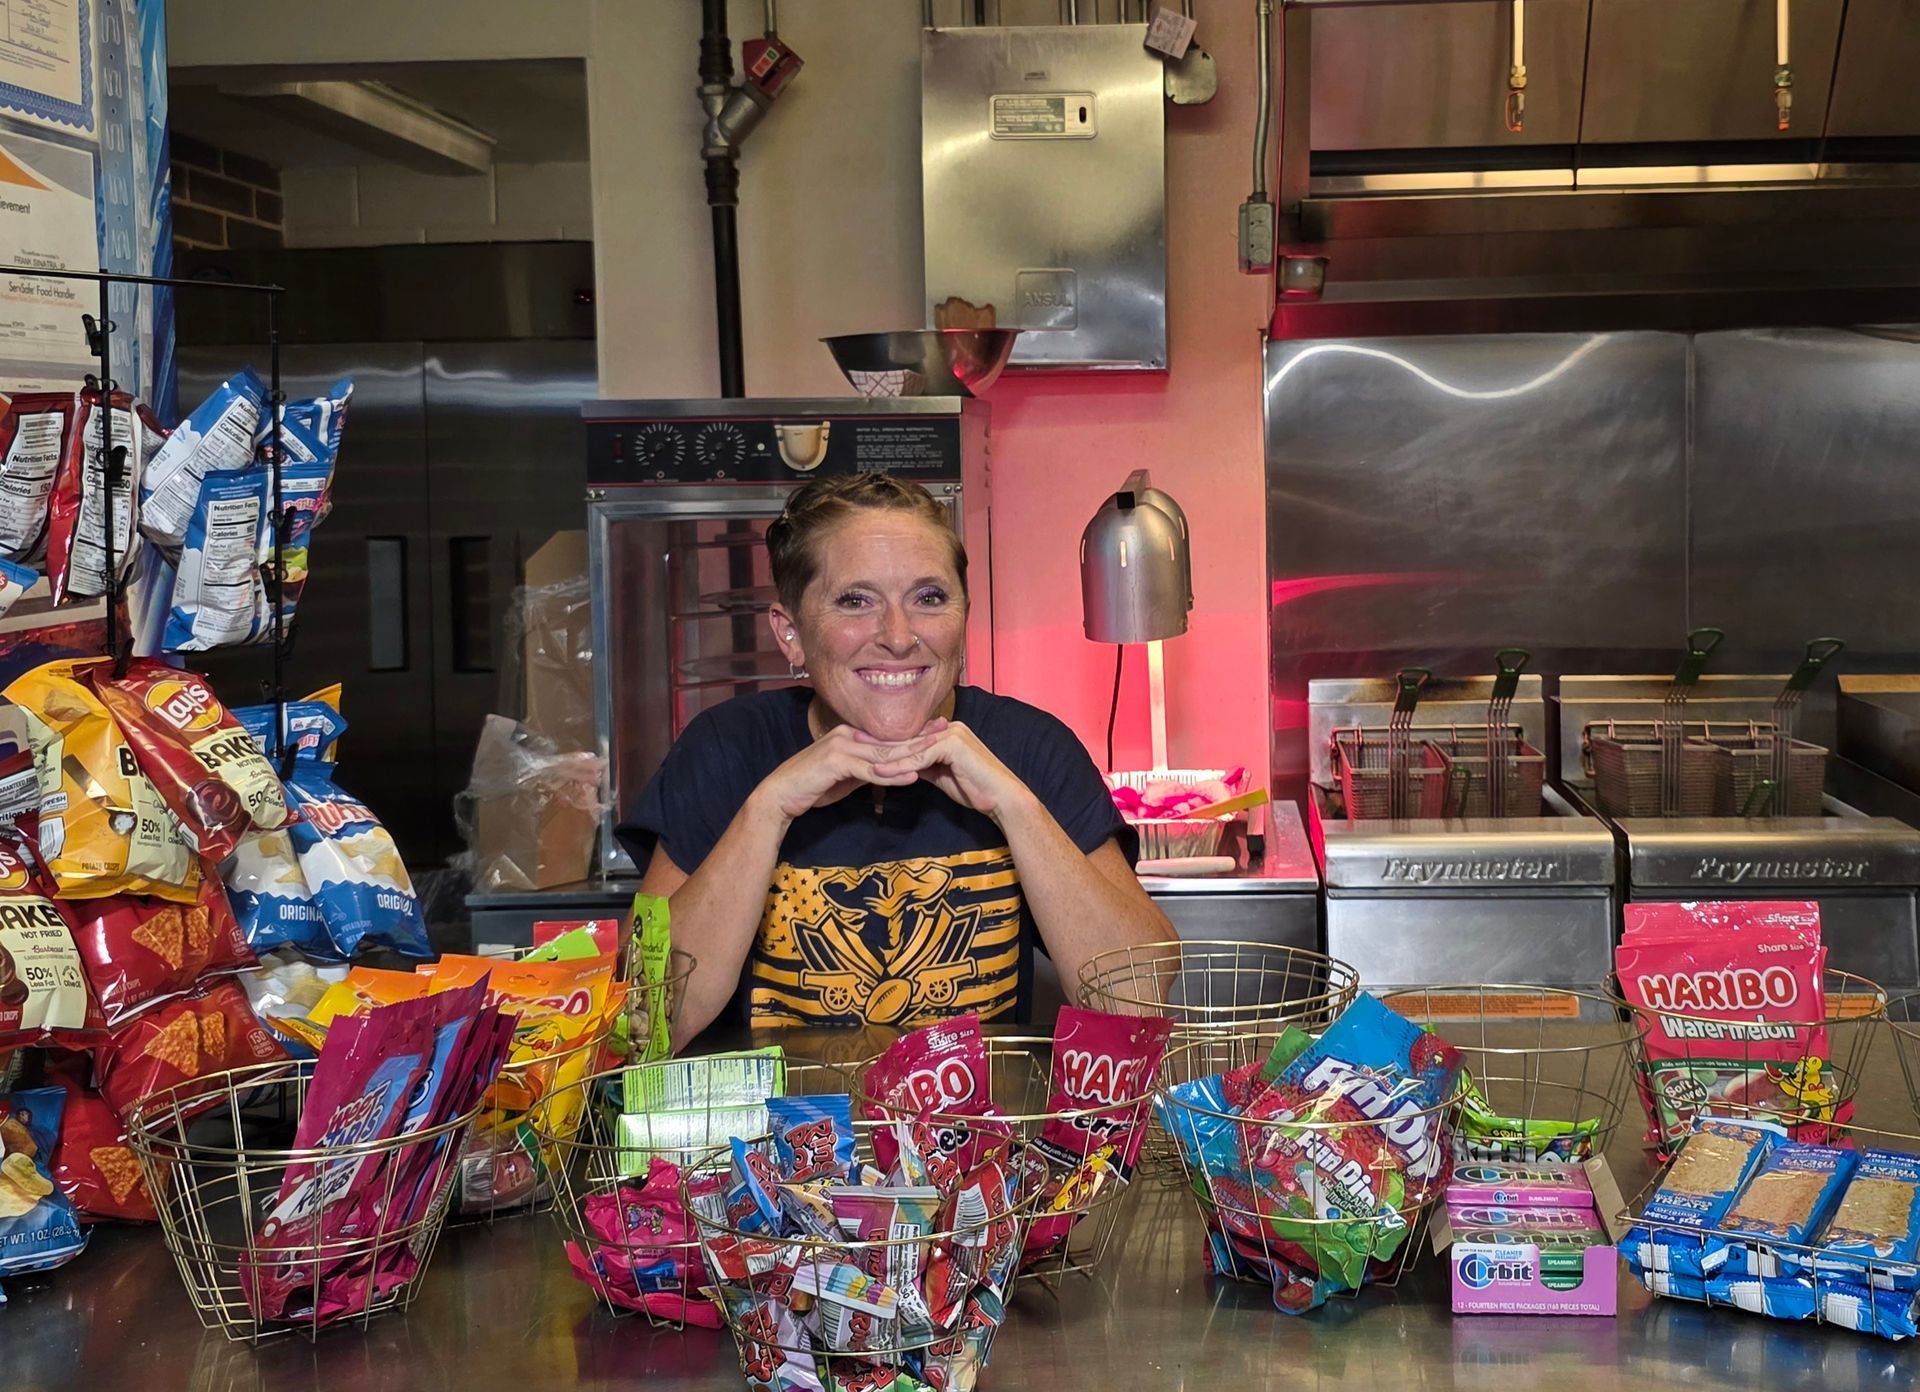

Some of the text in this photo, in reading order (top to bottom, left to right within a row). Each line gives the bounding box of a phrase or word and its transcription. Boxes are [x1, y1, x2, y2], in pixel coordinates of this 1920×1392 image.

[14, 255, 32, 266] FRANK
[36, 284, 53, 297] Food
[53, 286, 76, 300] Handler
[218, 421, 245, 444] Calories
[12, 453, 58, 463] Nutrition Facts
[213, 502, 243, 513] Nutrition
[211, 530, 238, 538] Calories
[153, 683, 210, 730] Lay's
[195, 735, 261, 770] BAKE
[141, 818, 161, 833] 50%
[1381, 856, 1562, 882] Frymaster
[1691, 857, 1870, 882] Frymaster
[0, 904, 65, 930] AKE
[279, 904, 323, 922] ORIGINA
[21, 930, 63, 939] NOT FRIED
[1757, 943, 1788, 953] Share
[26, 966, 53, 981] 50%
[1636, 965, 1798, 1011] HARIBO
[959, 1028, 975, 1039] Size
[1659, 1014, 1797, 1041] Watermelon
[249, 1030, 267, 1044] 150
[1665, 1079, 1692, 1096] Soft
[1374, 1098, 1443, 1180] Dip
[1297, 1129, 1344, 1173] Fun
[1493, 1190, 1518, 1204] Orbit
[1644, 1210, 1703, 1226] MEGA SIZE
[10, 1232, 28, 1245] WT.
[1457, 1252, 1534, 1290] Orbit
[1468, 1301, 1499, 1310] FOURTEEN
[1500, 1302, 1515, 1310] PIECE
[1516, 1302, 1547, 1311] PACKAGES
[1560, 1303, 1579, 1311] PIECES
